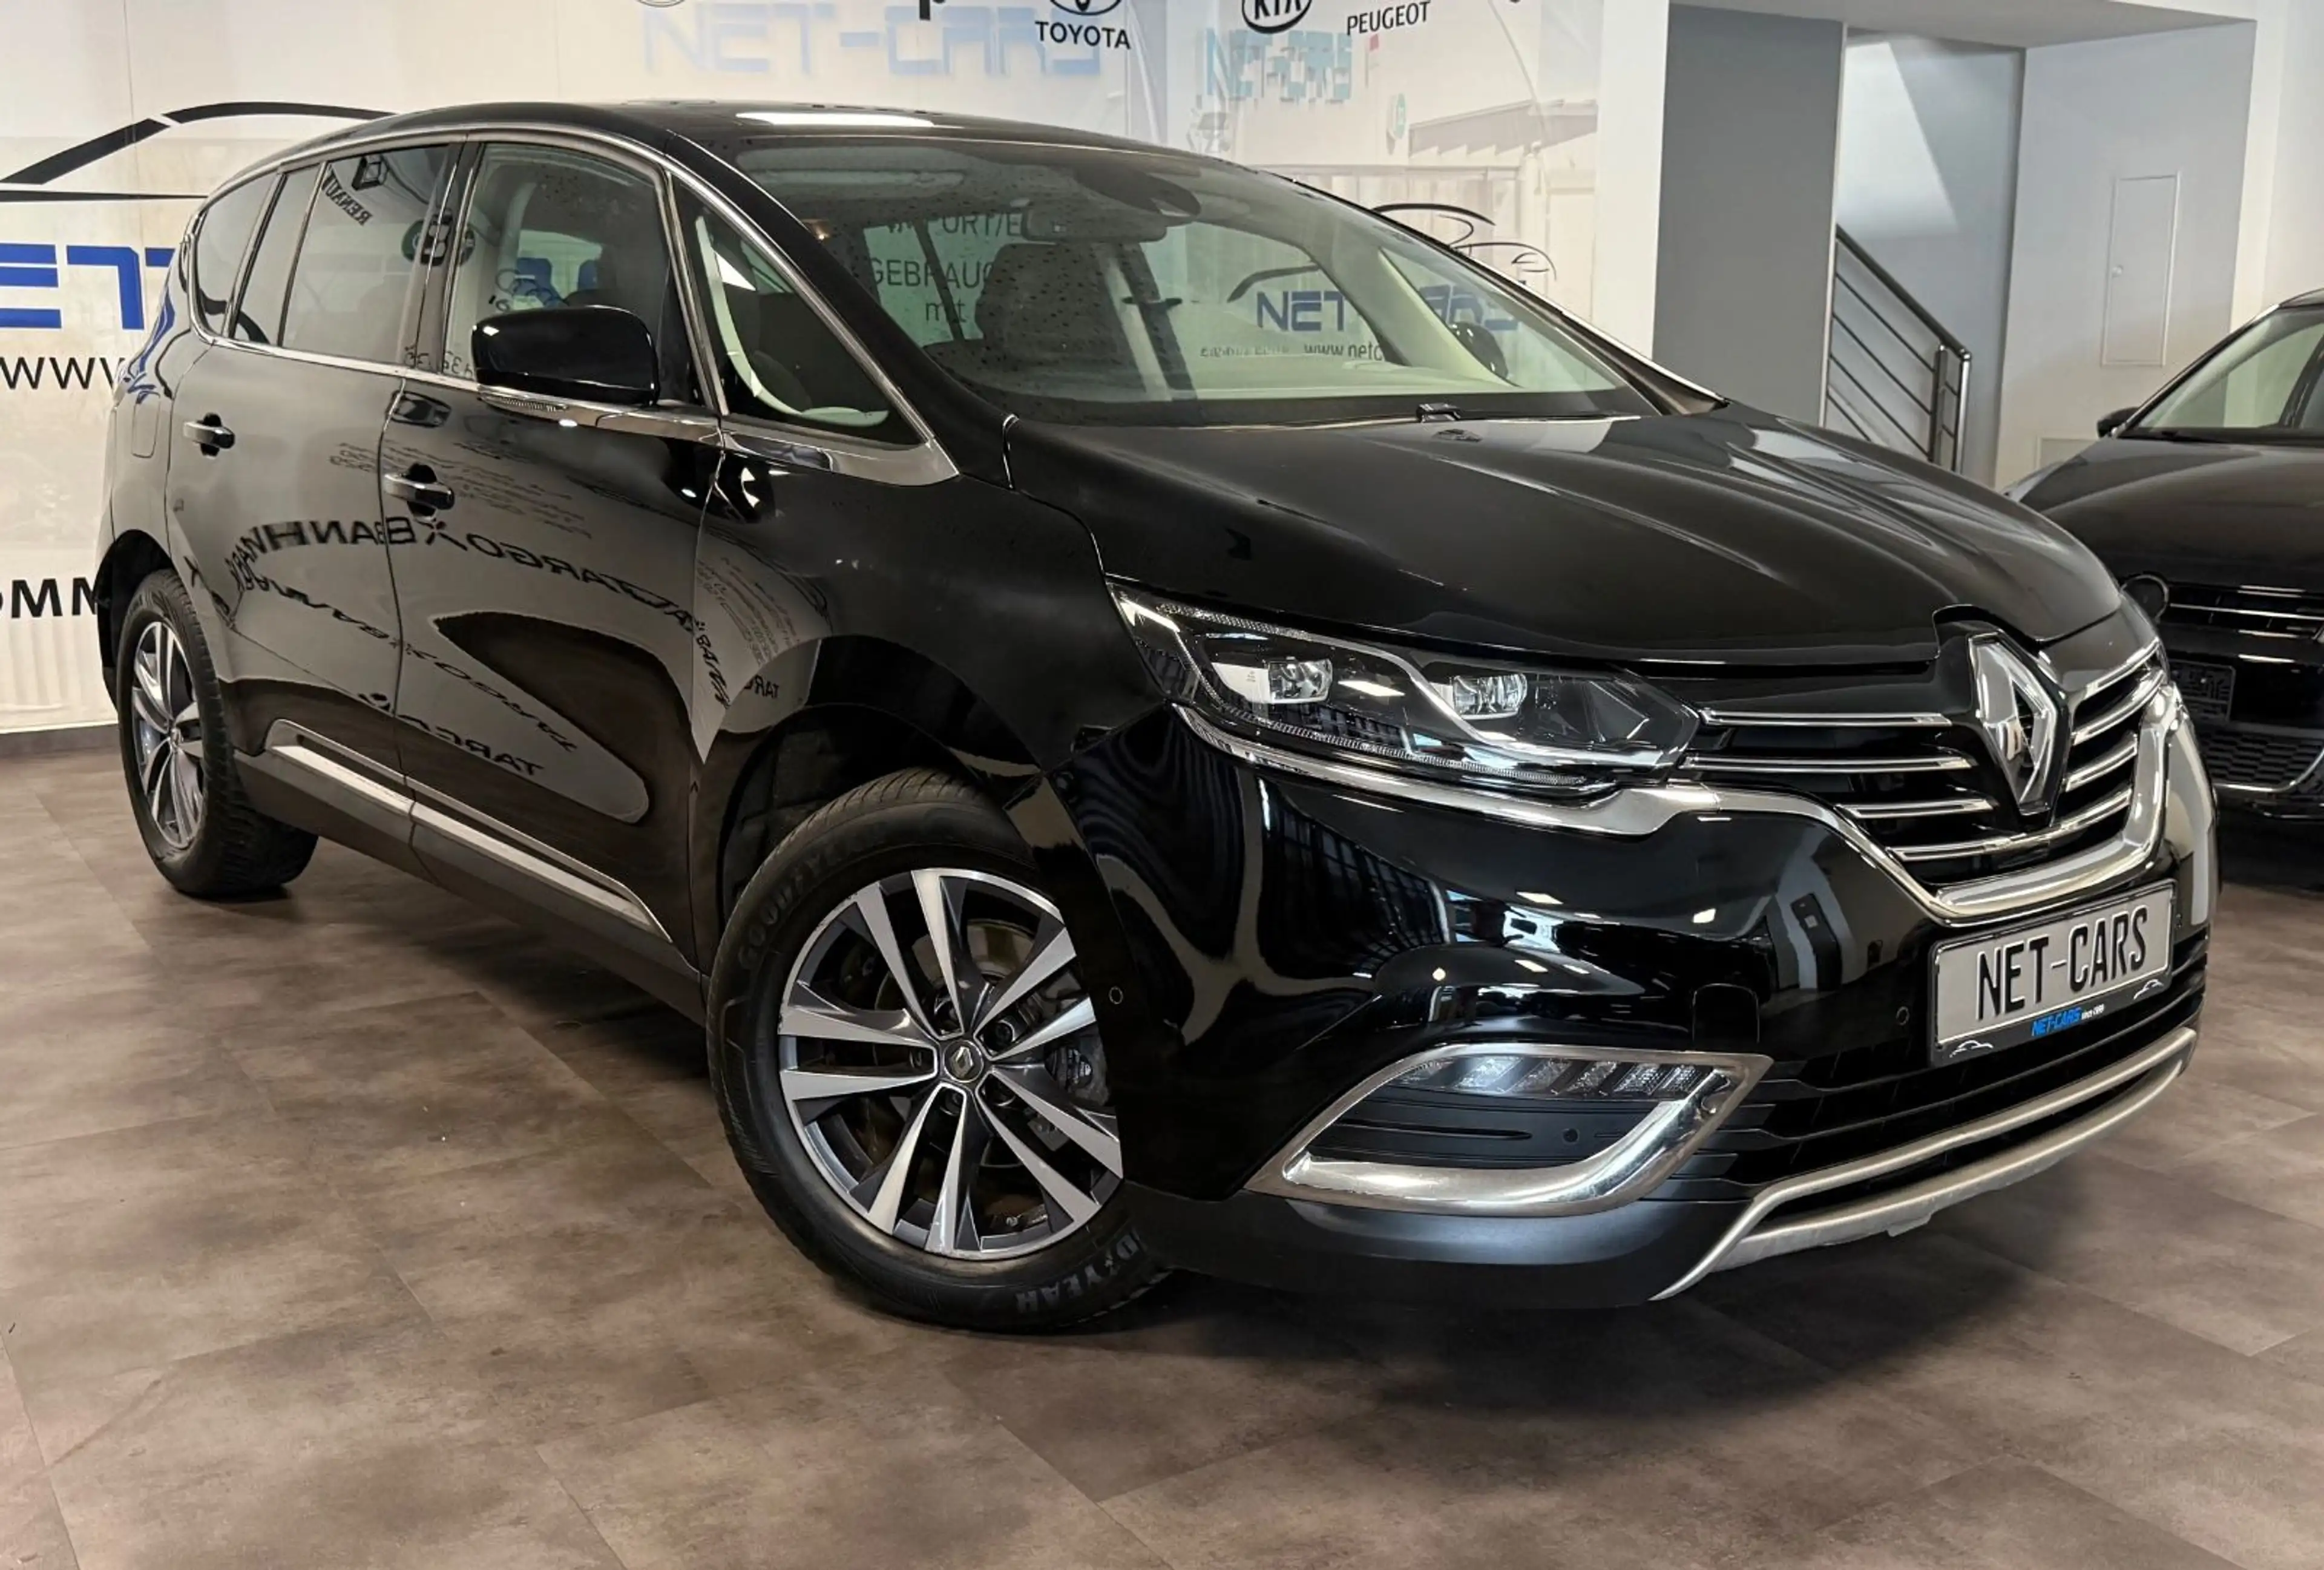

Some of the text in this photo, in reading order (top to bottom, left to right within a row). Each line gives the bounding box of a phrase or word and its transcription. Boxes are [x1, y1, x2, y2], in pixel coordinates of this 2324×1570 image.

[1347, 1, 1430, 35] PEUGEOT
[1035, 21, 1131, 50] TOYOTA
[1977, 905, 2148, 1022] NET-CARS
